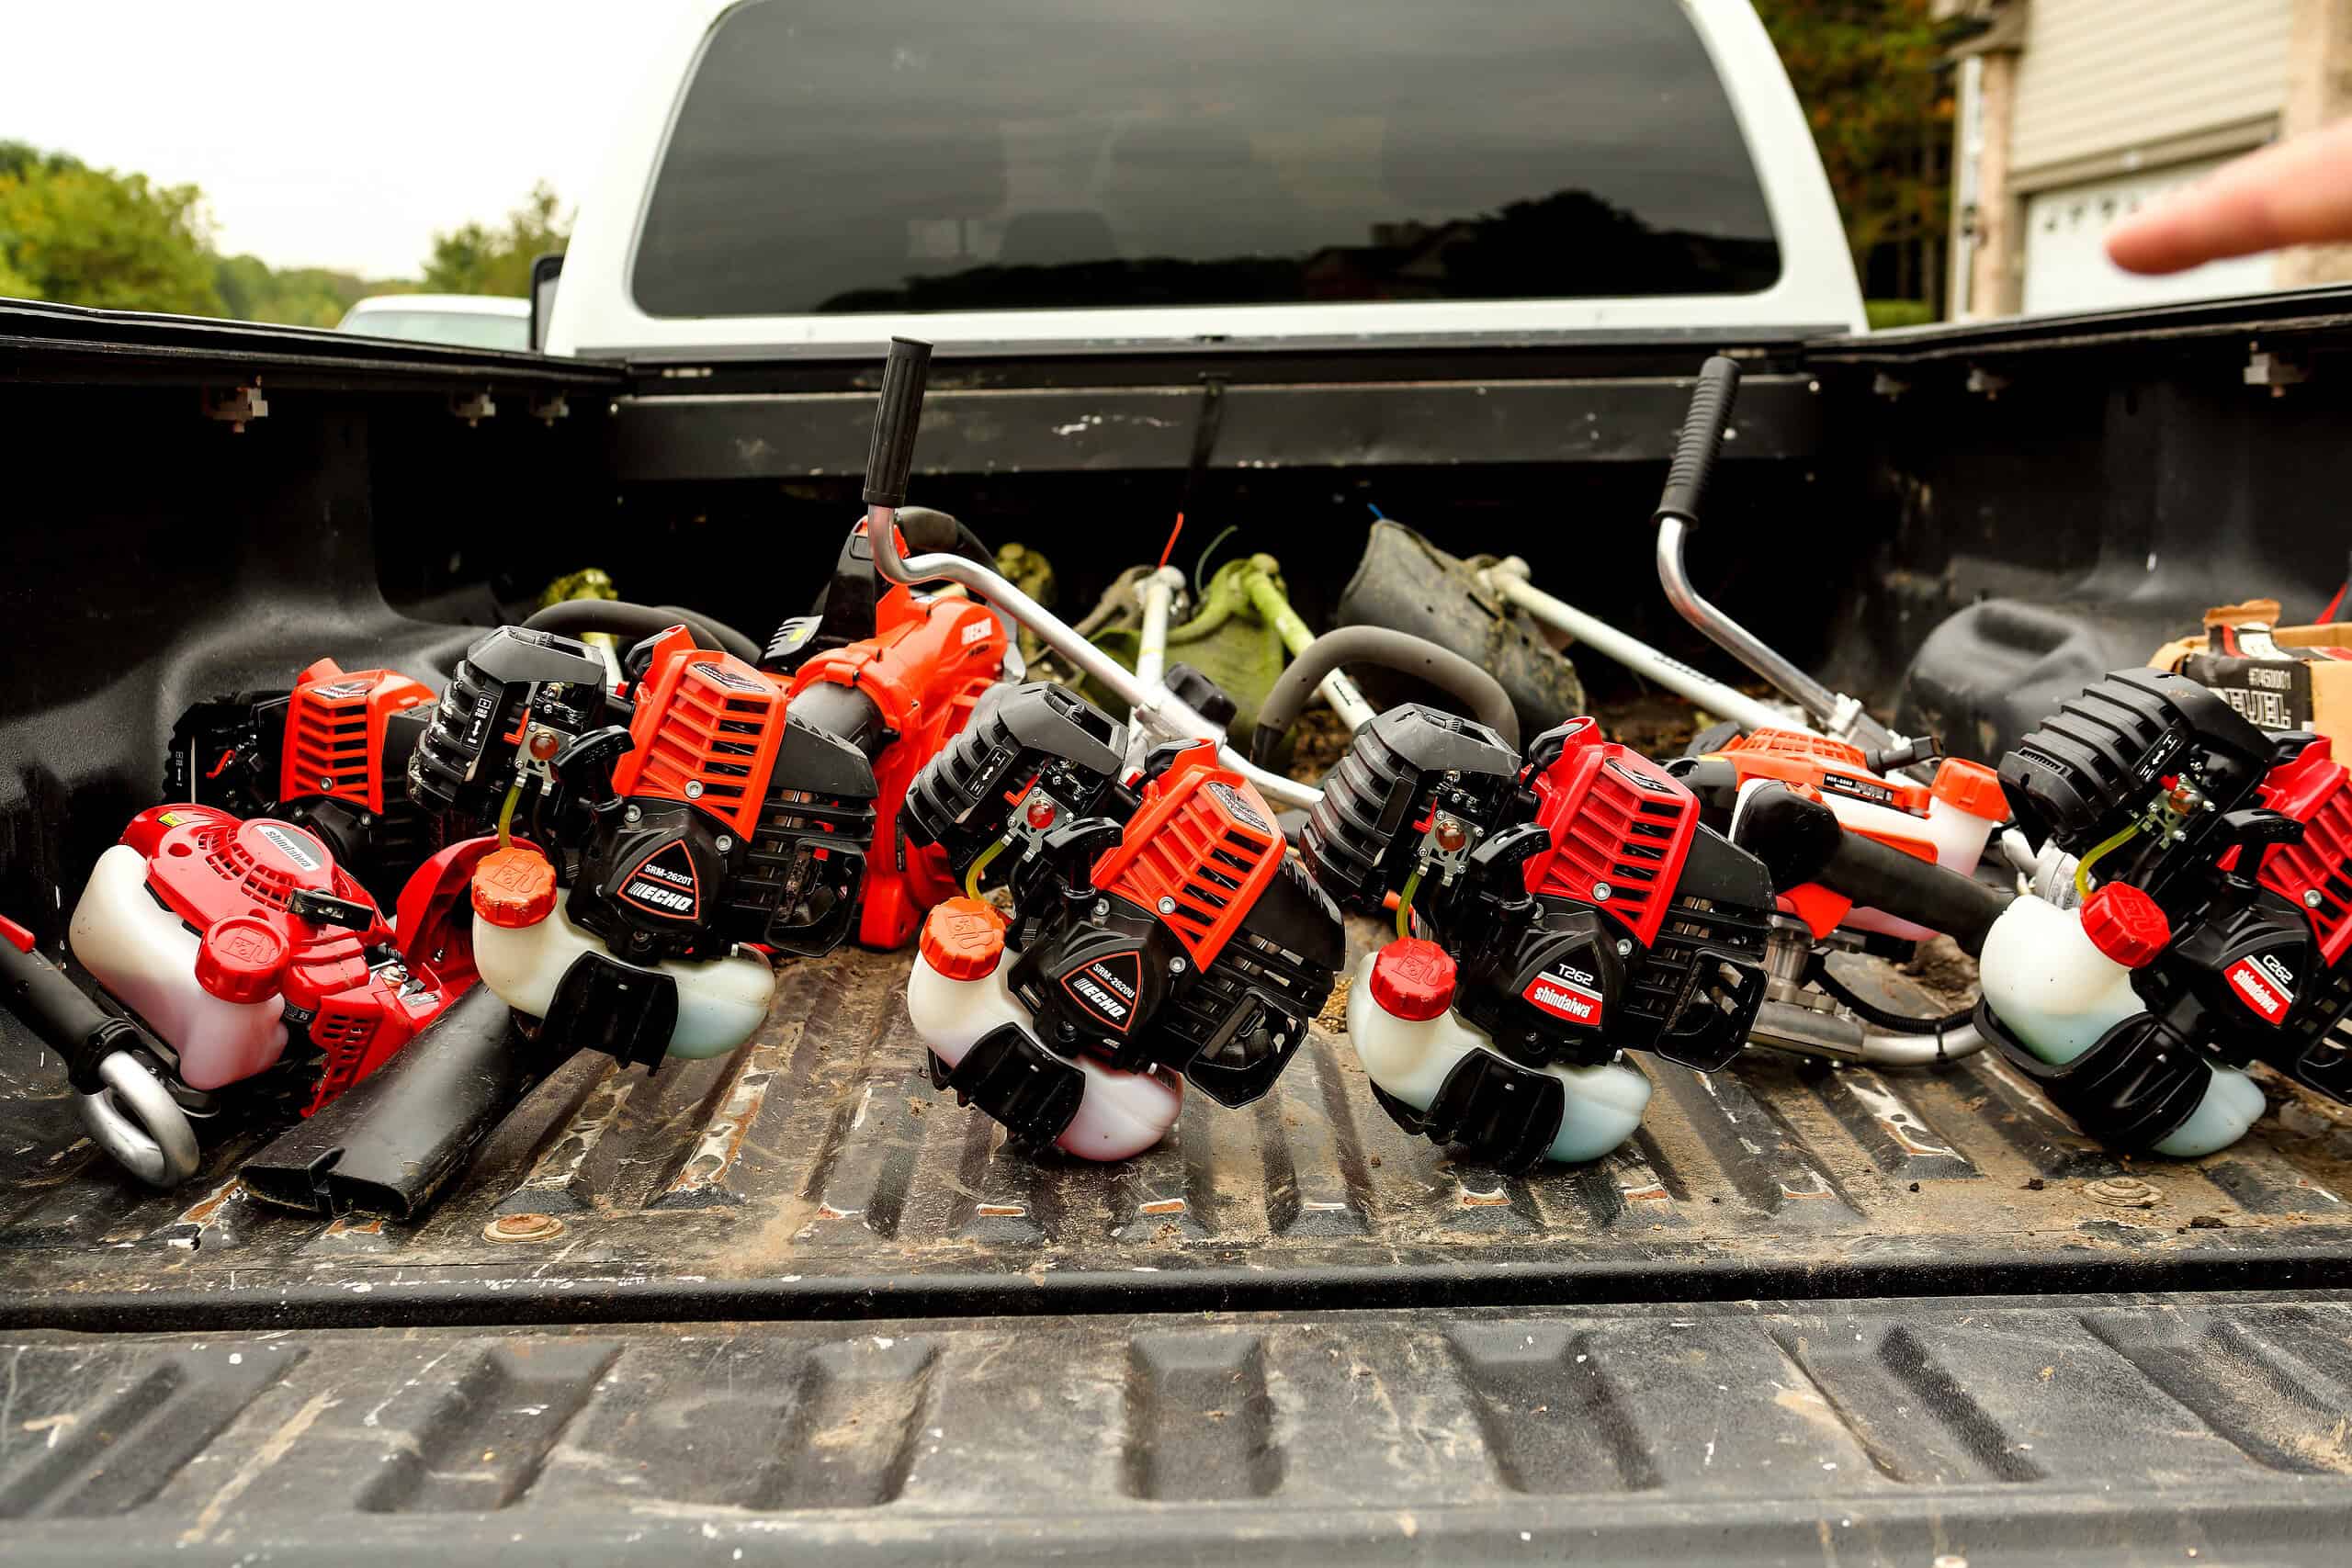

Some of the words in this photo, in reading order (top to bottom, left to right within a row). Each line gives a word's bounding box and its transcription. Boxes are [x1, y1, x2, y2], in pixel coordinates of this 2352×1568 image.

[644, 863, 694, 886] SRM-2620T
[634, 883, 694, 911] ECHO
[1092, 963, 1136, 998] SRM-2620U
[1559, 963, 1595, 987] T262
[2262, 954, 2294, 985] C262
[1079, 981, 1126, 1018] ECHO
[1533, 986, 1592, 1019] shindaiwa
[2233, 969, 2280, 1015] shindaiwa
